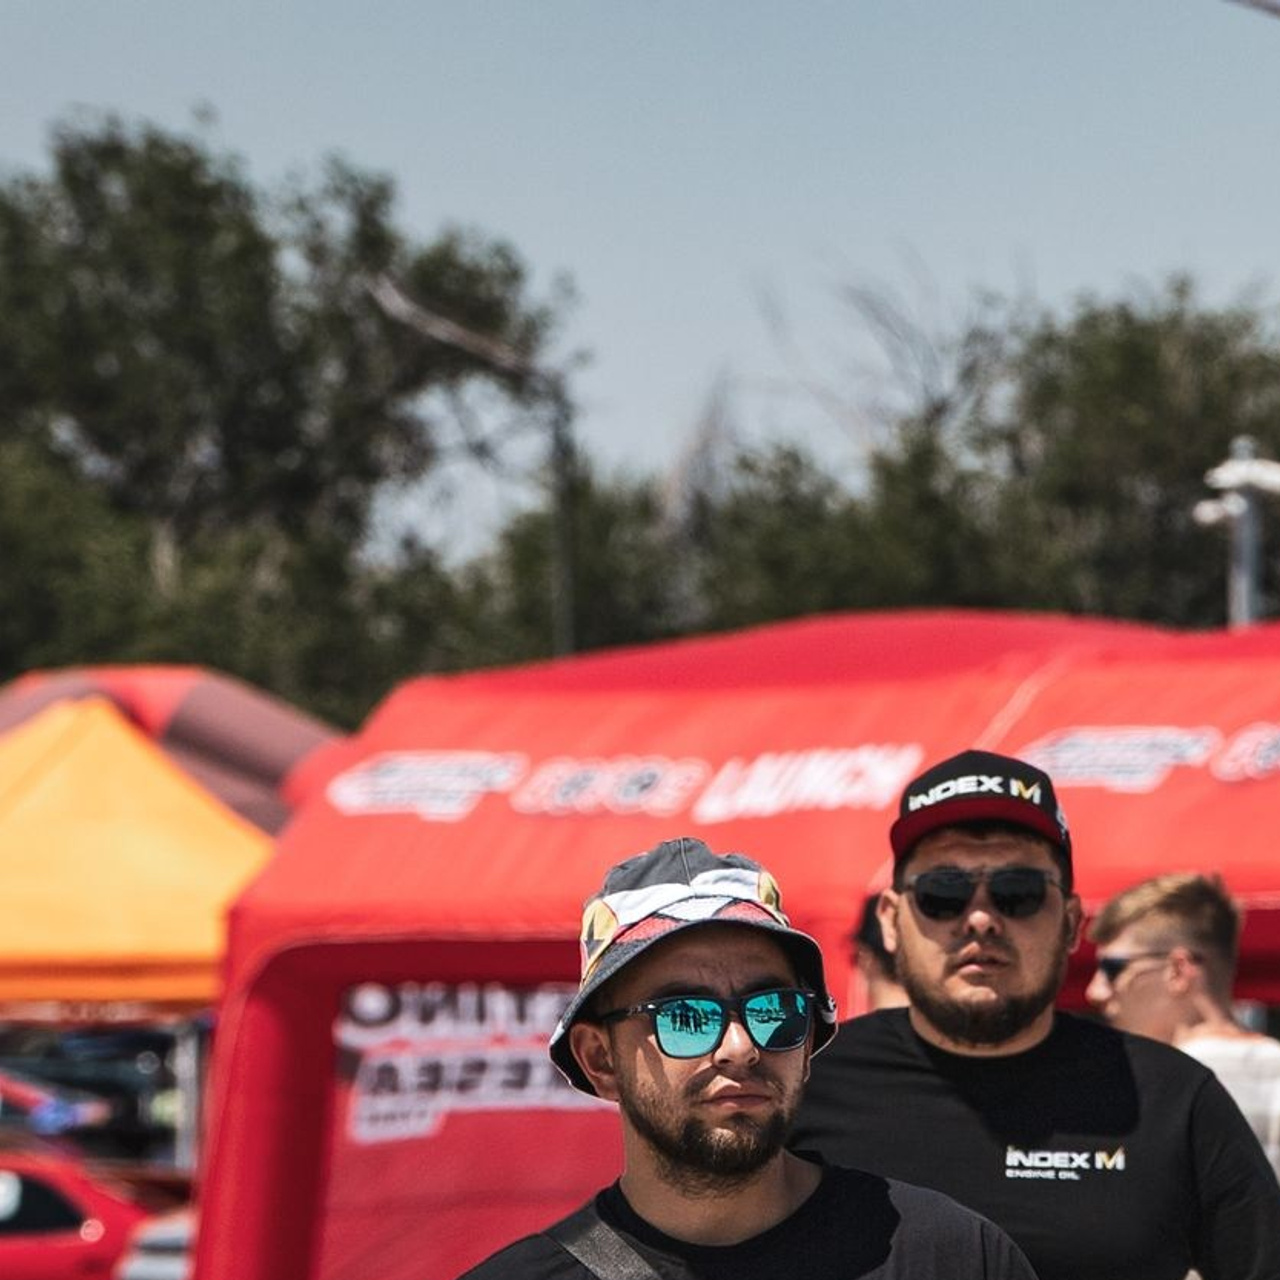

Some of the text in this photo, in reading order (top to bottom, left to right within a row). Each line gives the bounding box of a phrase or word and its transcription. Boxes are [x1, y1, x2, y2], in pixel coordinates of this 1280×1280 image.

[908, 775, 1041, 811] INDEX M
[1005, 1145, 1126, 1171] INDEX M
